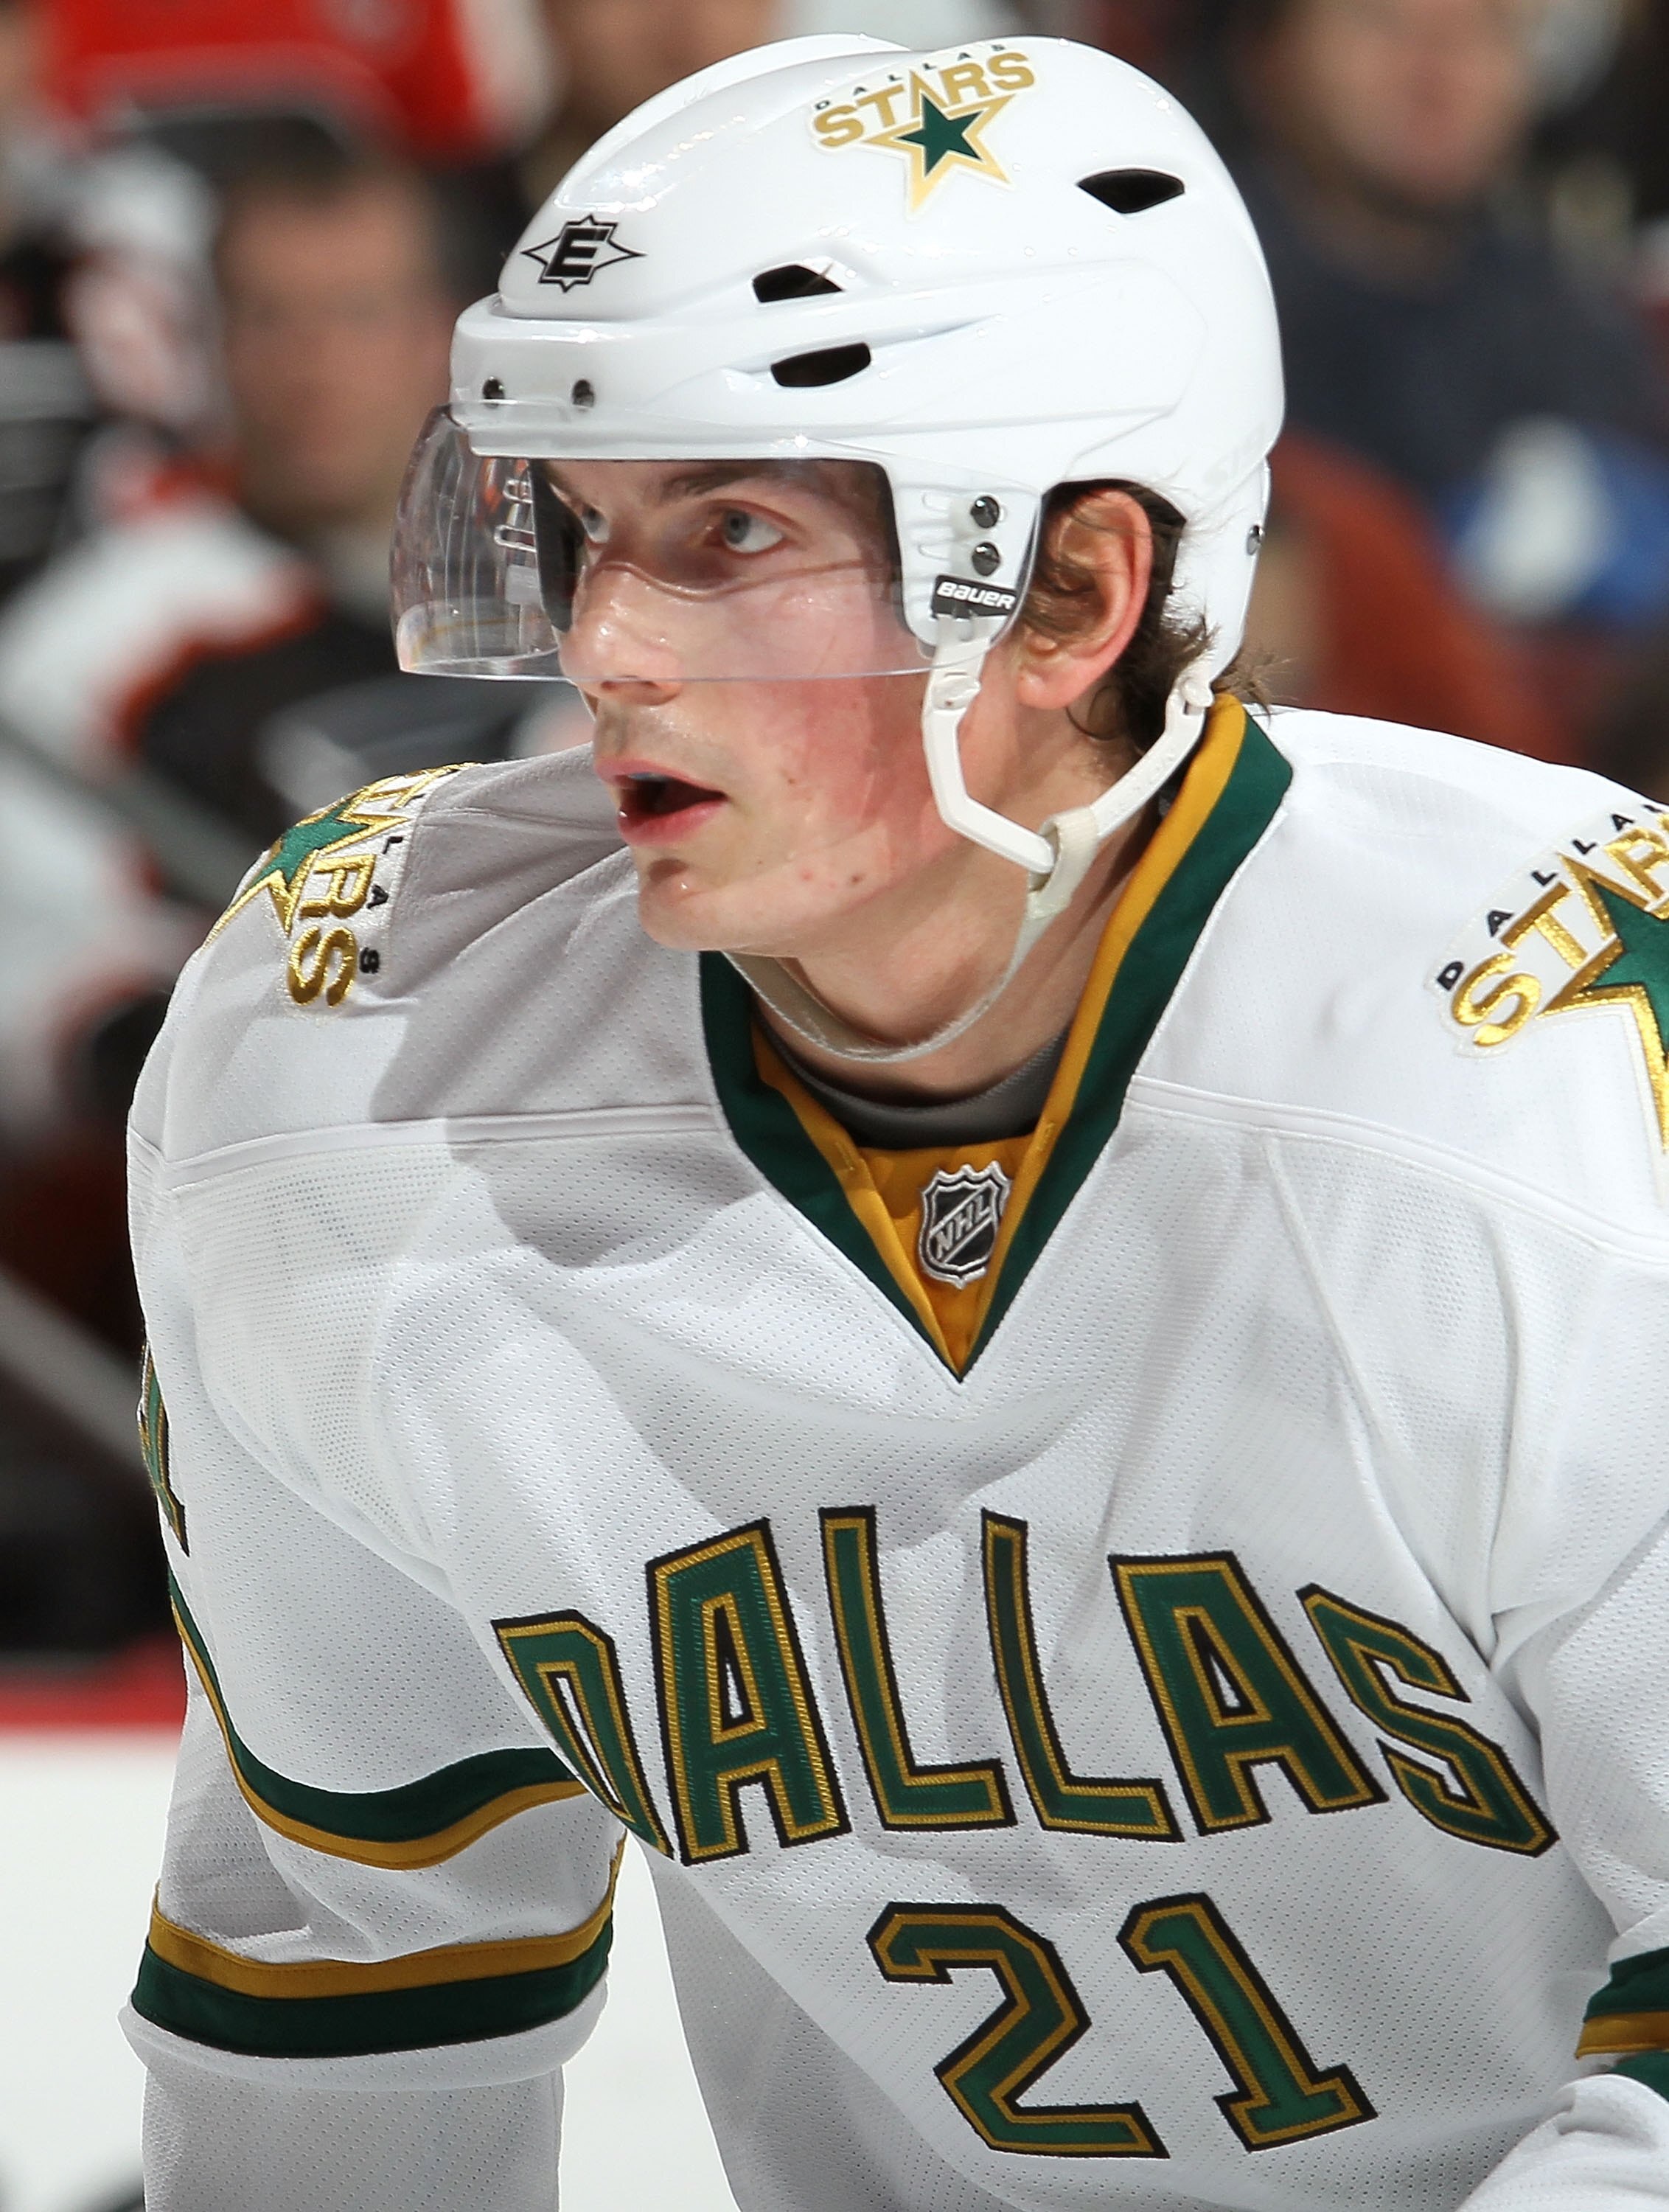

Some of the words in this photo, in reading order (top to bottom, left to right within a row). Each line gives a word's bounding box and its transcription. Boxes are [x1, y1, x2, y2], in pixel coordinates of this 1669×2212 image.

[813, 52, 1035, 147] STARS
[815, 44, 1006, 110] DALLAS
[545, 227, 611, 277] E
[1452, 814, 1669, 1047] STAR
[935, 1194, 991, 1259] NHL
[492, 1506, 1561, 1865] DALLAS
[867, 1893, 1379, 2160] 21
